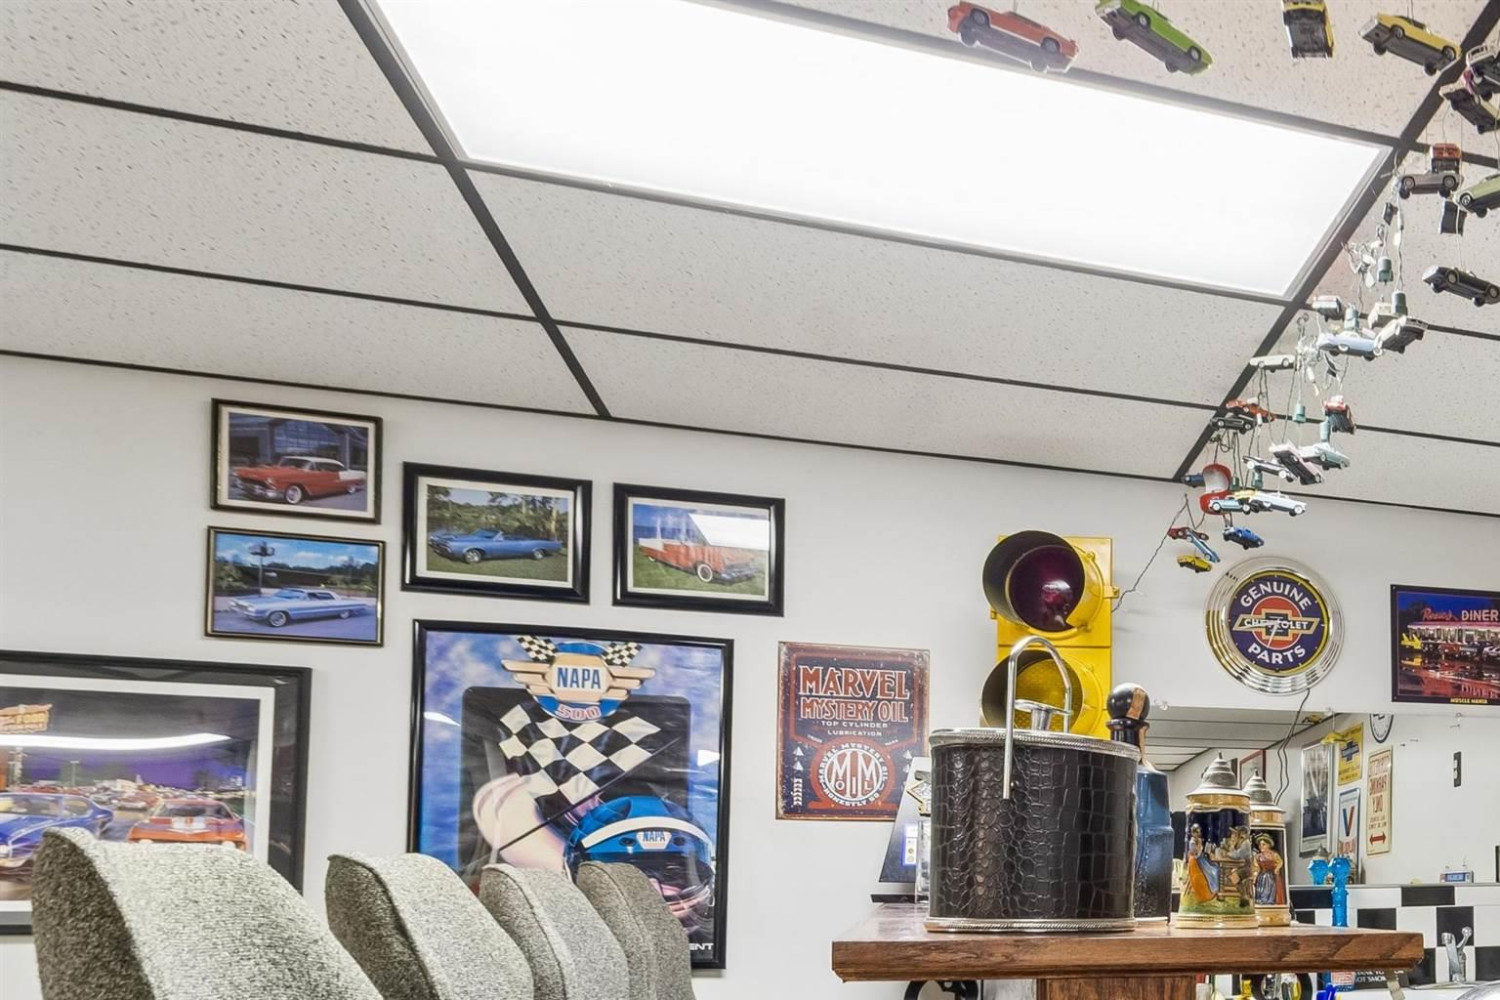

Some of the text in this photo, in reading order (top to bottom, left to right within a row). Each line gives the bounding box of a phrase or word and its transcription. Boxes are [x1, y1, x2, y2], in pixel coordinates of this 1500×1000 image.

[1240, 581, 1312, 611] GENUINE
[1461, 609, 1500, 621] DINER
[1247, 643, 1306, 664] PARTS
[557, 665, 602, 690] NAPA
[798, 665, 910, 699] MARVEL
[556, 704, 602, 720] 500
[800, 697, 909, 722] MYSTERY OIL
[642, 831, 666, 843] NAPA
